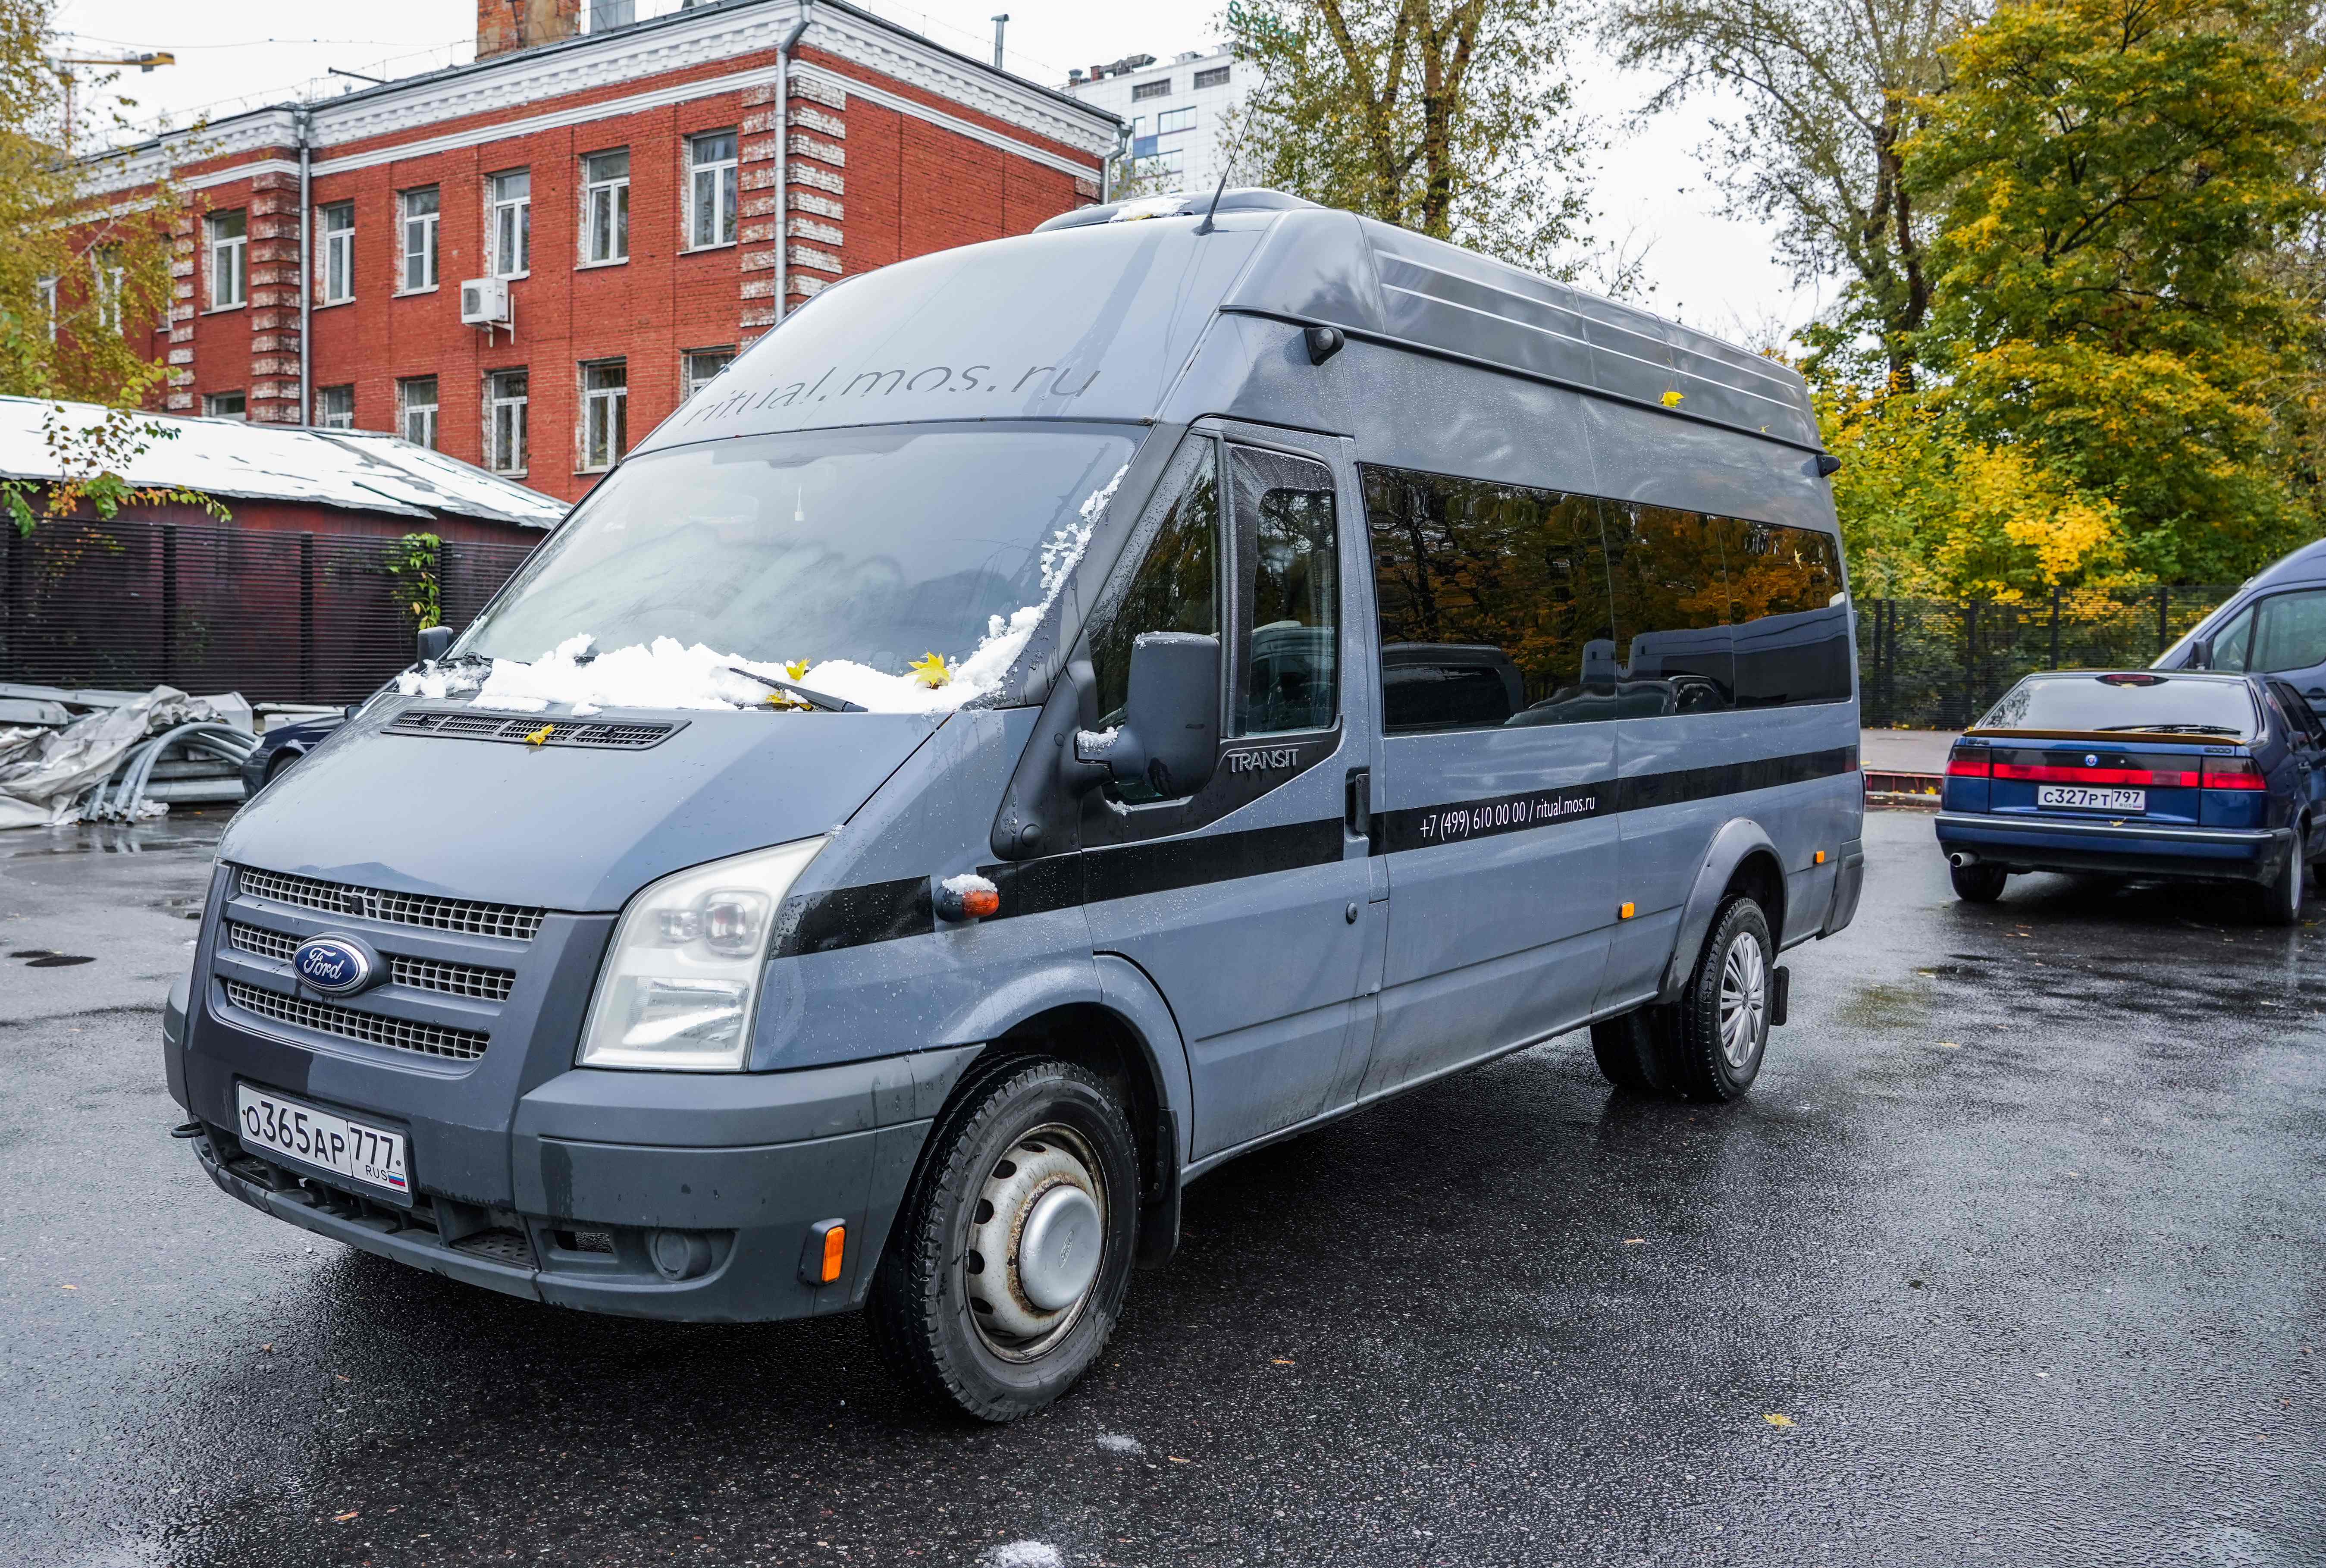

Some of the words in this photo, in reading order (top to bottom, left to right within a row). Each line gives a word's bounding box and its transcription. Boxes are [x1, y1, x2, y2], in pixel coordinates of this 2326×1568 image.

[683, 365, 1101, 426] ritual.mos.ru
[1227, 749, 1299, 772] TRANSIT
[2114, 791, 2140, 803] 797
[1420, 815, 1436, 837] +7
[1441, 810, 1469, 840] (499)
[1473, 806, 1491, 830] 610
[1496, 804, 1509, 826] 00
[1513, 801, 1525, 823] 00
[1537, 796, 1595, 818] ritual.mos.ru
[304, 947, 345, 979] Ford
[247, 1100, 345, 1164] О365АР
[350, 1127, 393, 1169] 777
[366, 1165, 388, 1181] RUS
